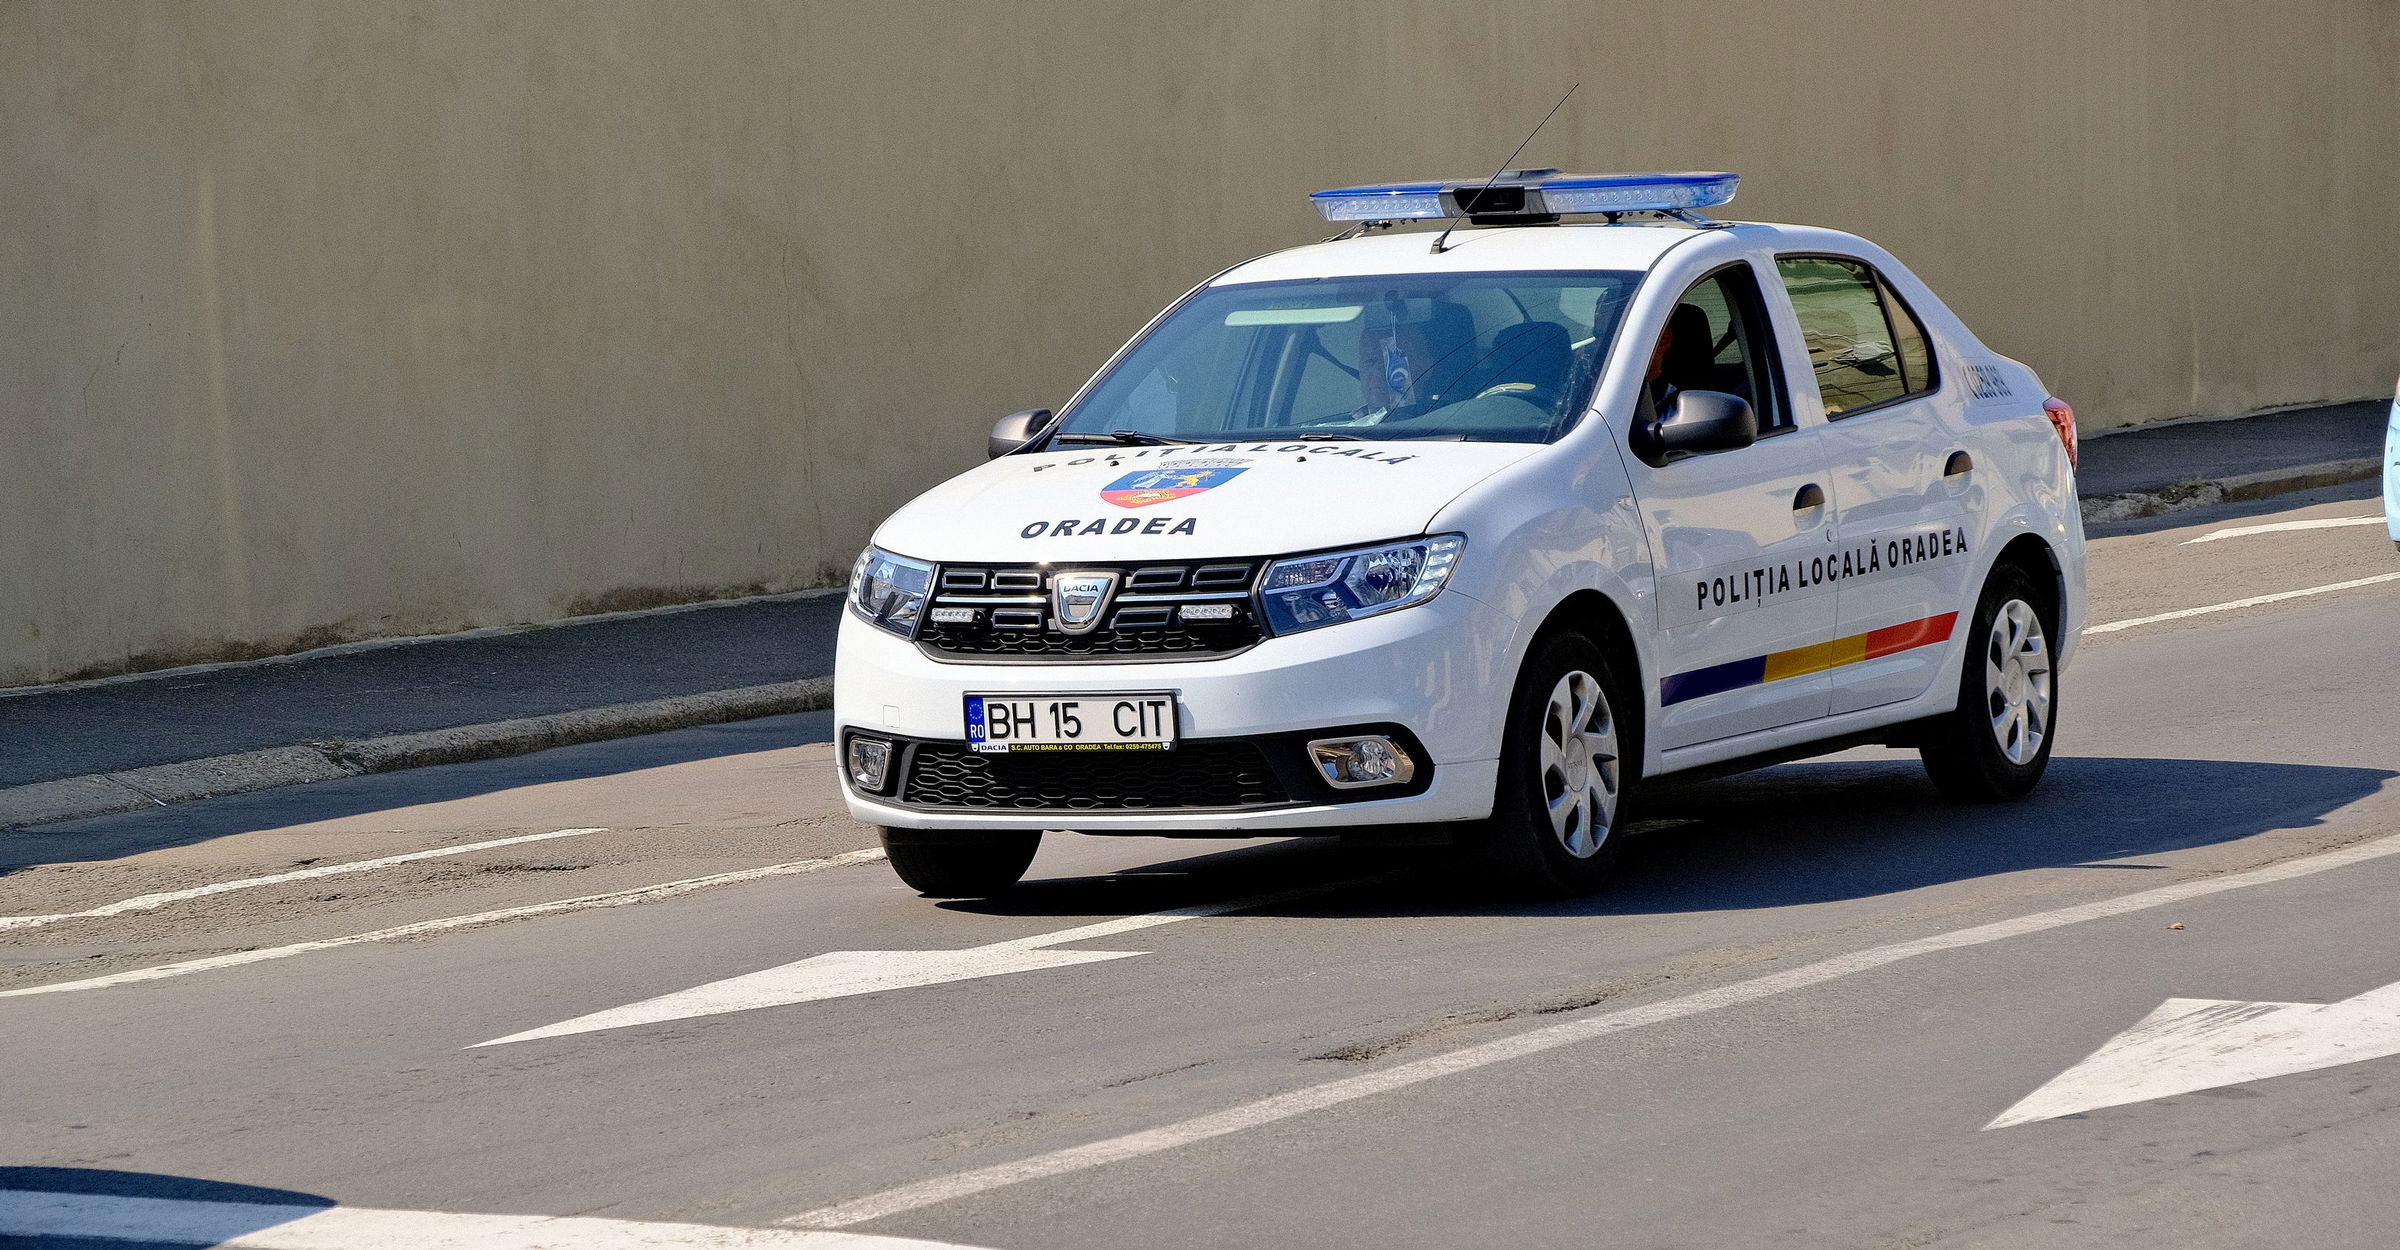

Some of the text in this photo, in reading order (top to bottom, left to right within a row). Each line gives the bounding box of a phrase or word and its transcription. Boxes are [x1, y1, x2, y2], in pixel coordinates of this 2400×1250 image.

[1248, 444, 1420, 465] LOCALĂ
[1021, 518, 1197, 538] ORADEA
[1697, 527, 1968, 610] POLIȚIA LOCALĂ ORADEA
[1063, 584, 1099, 593] DACIA
[988, 701, 1166, 739] BH 15 CIT
[970, 724, 985, 739] RO
